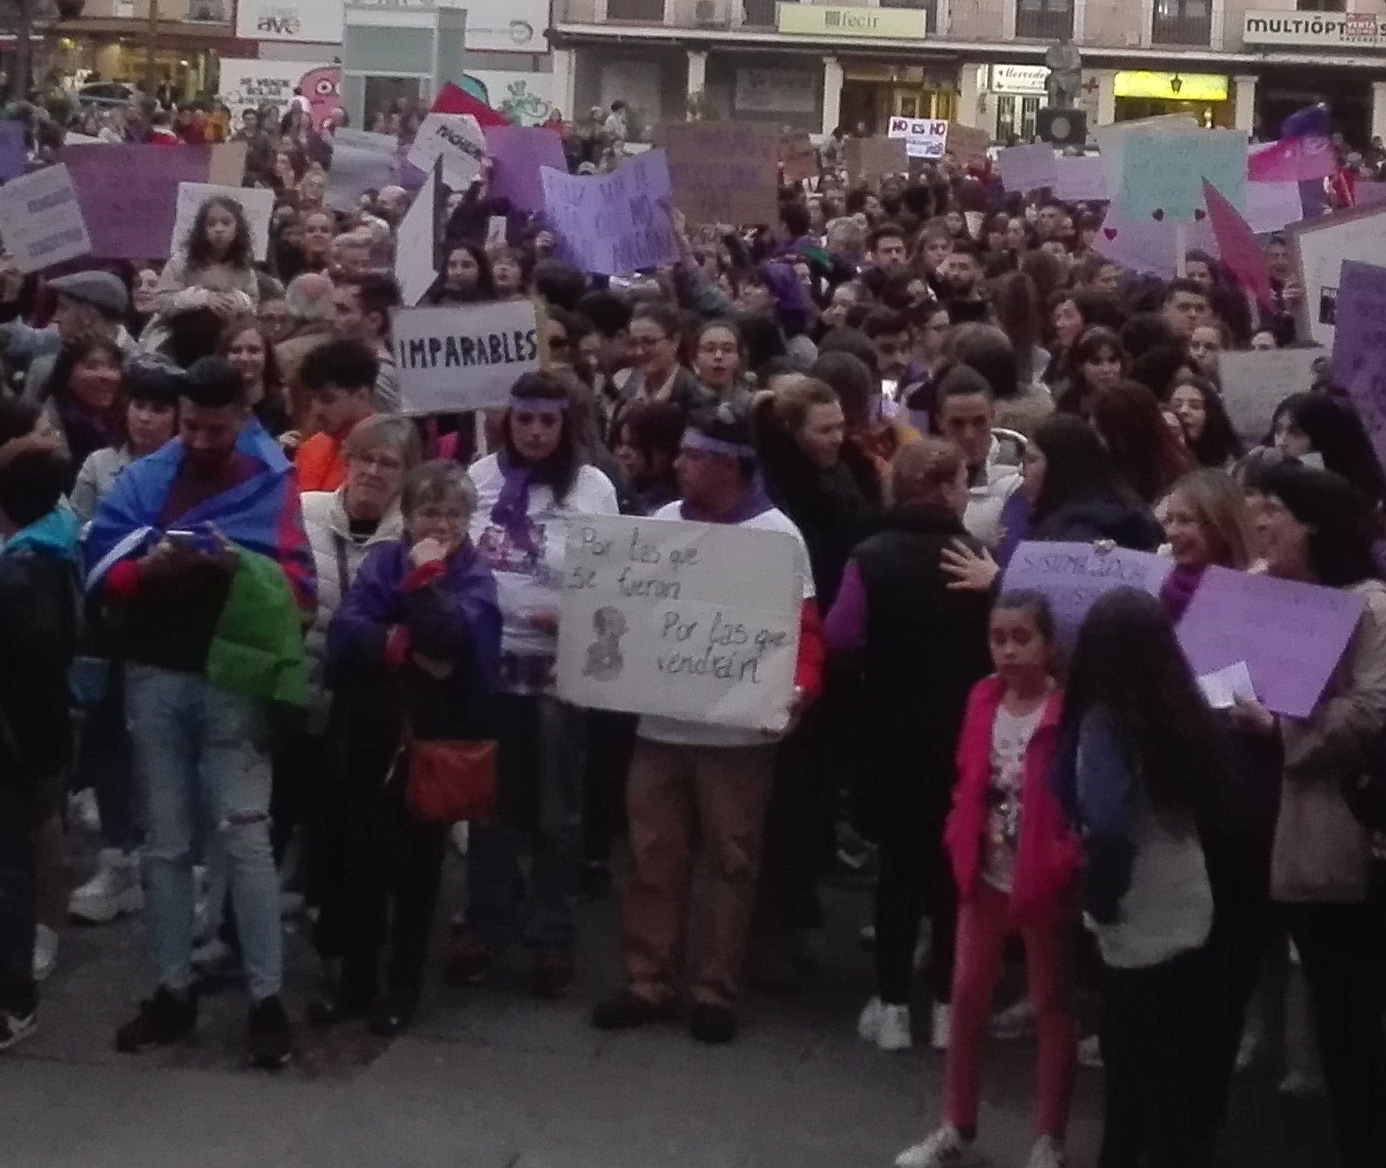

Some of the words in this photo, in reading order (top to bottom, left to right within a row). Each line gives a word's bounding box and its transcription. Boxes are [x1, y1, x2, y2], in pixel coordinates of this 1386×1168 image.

[930, 122, 945, 135] NO
[400, 329, 538, 369] IMPARABLES
[581, 526, 613, 557] Por
[669, 547, 700, 570] que
[662, 610, 696, 643] Por
[754, 628, 791, 654] que
